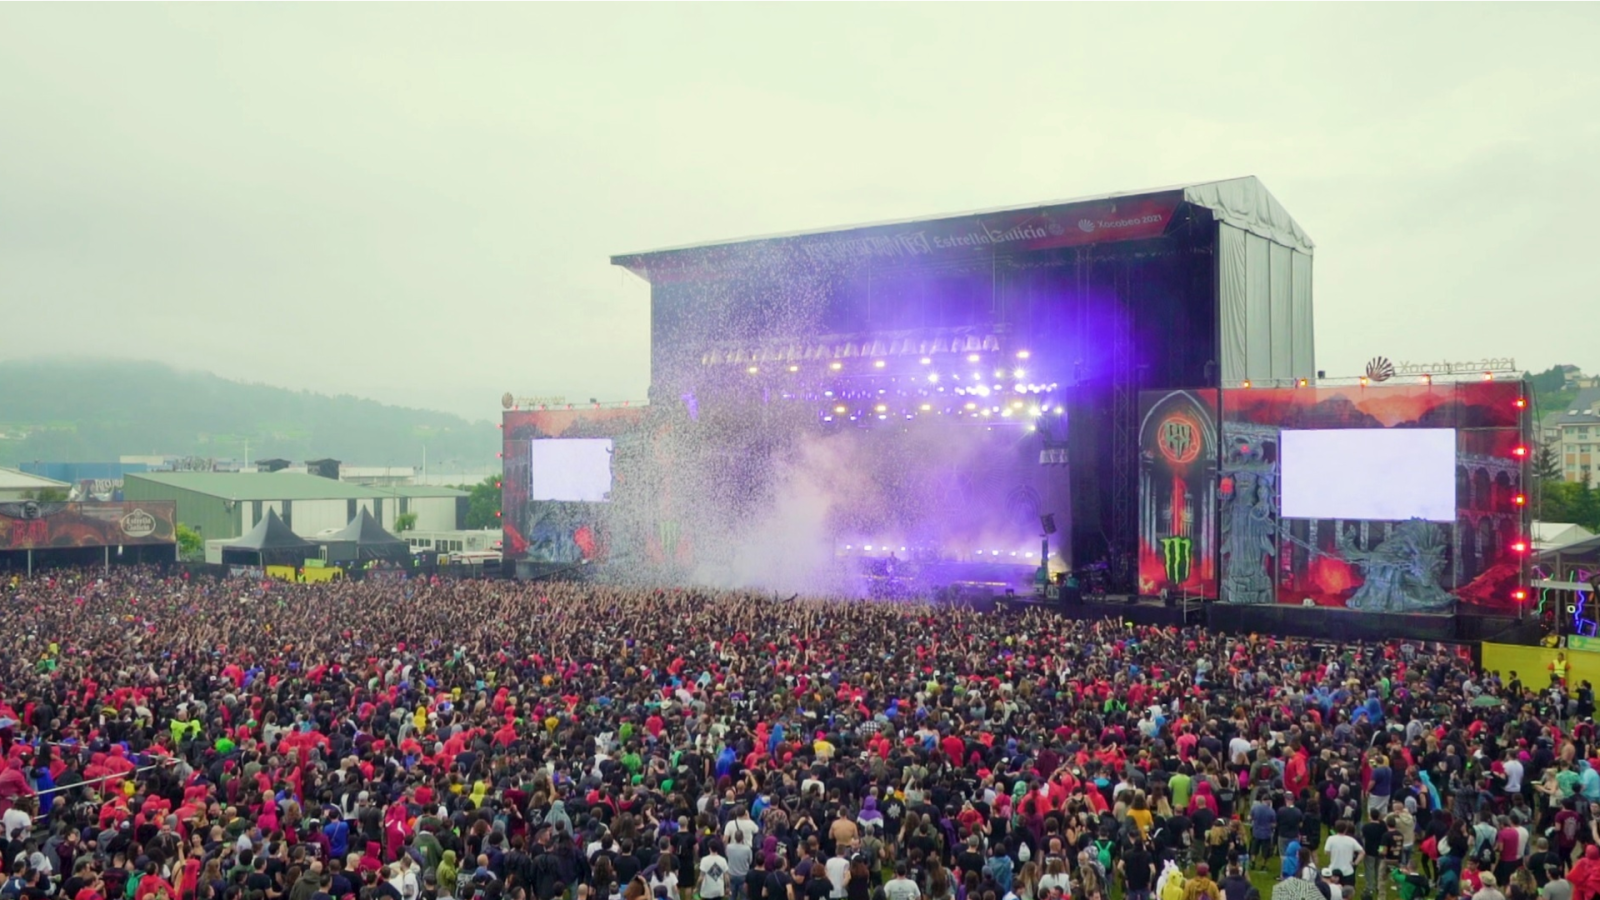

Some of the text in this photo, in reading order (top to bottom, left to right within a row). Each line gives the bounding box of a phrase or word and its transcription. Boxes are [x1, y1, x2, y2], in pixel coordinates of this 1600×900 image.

[1142, 213, 1163, 224] 2021
[933, 231, 989, 249] Estrella
[1480, 357, 1517, 371] 2021
